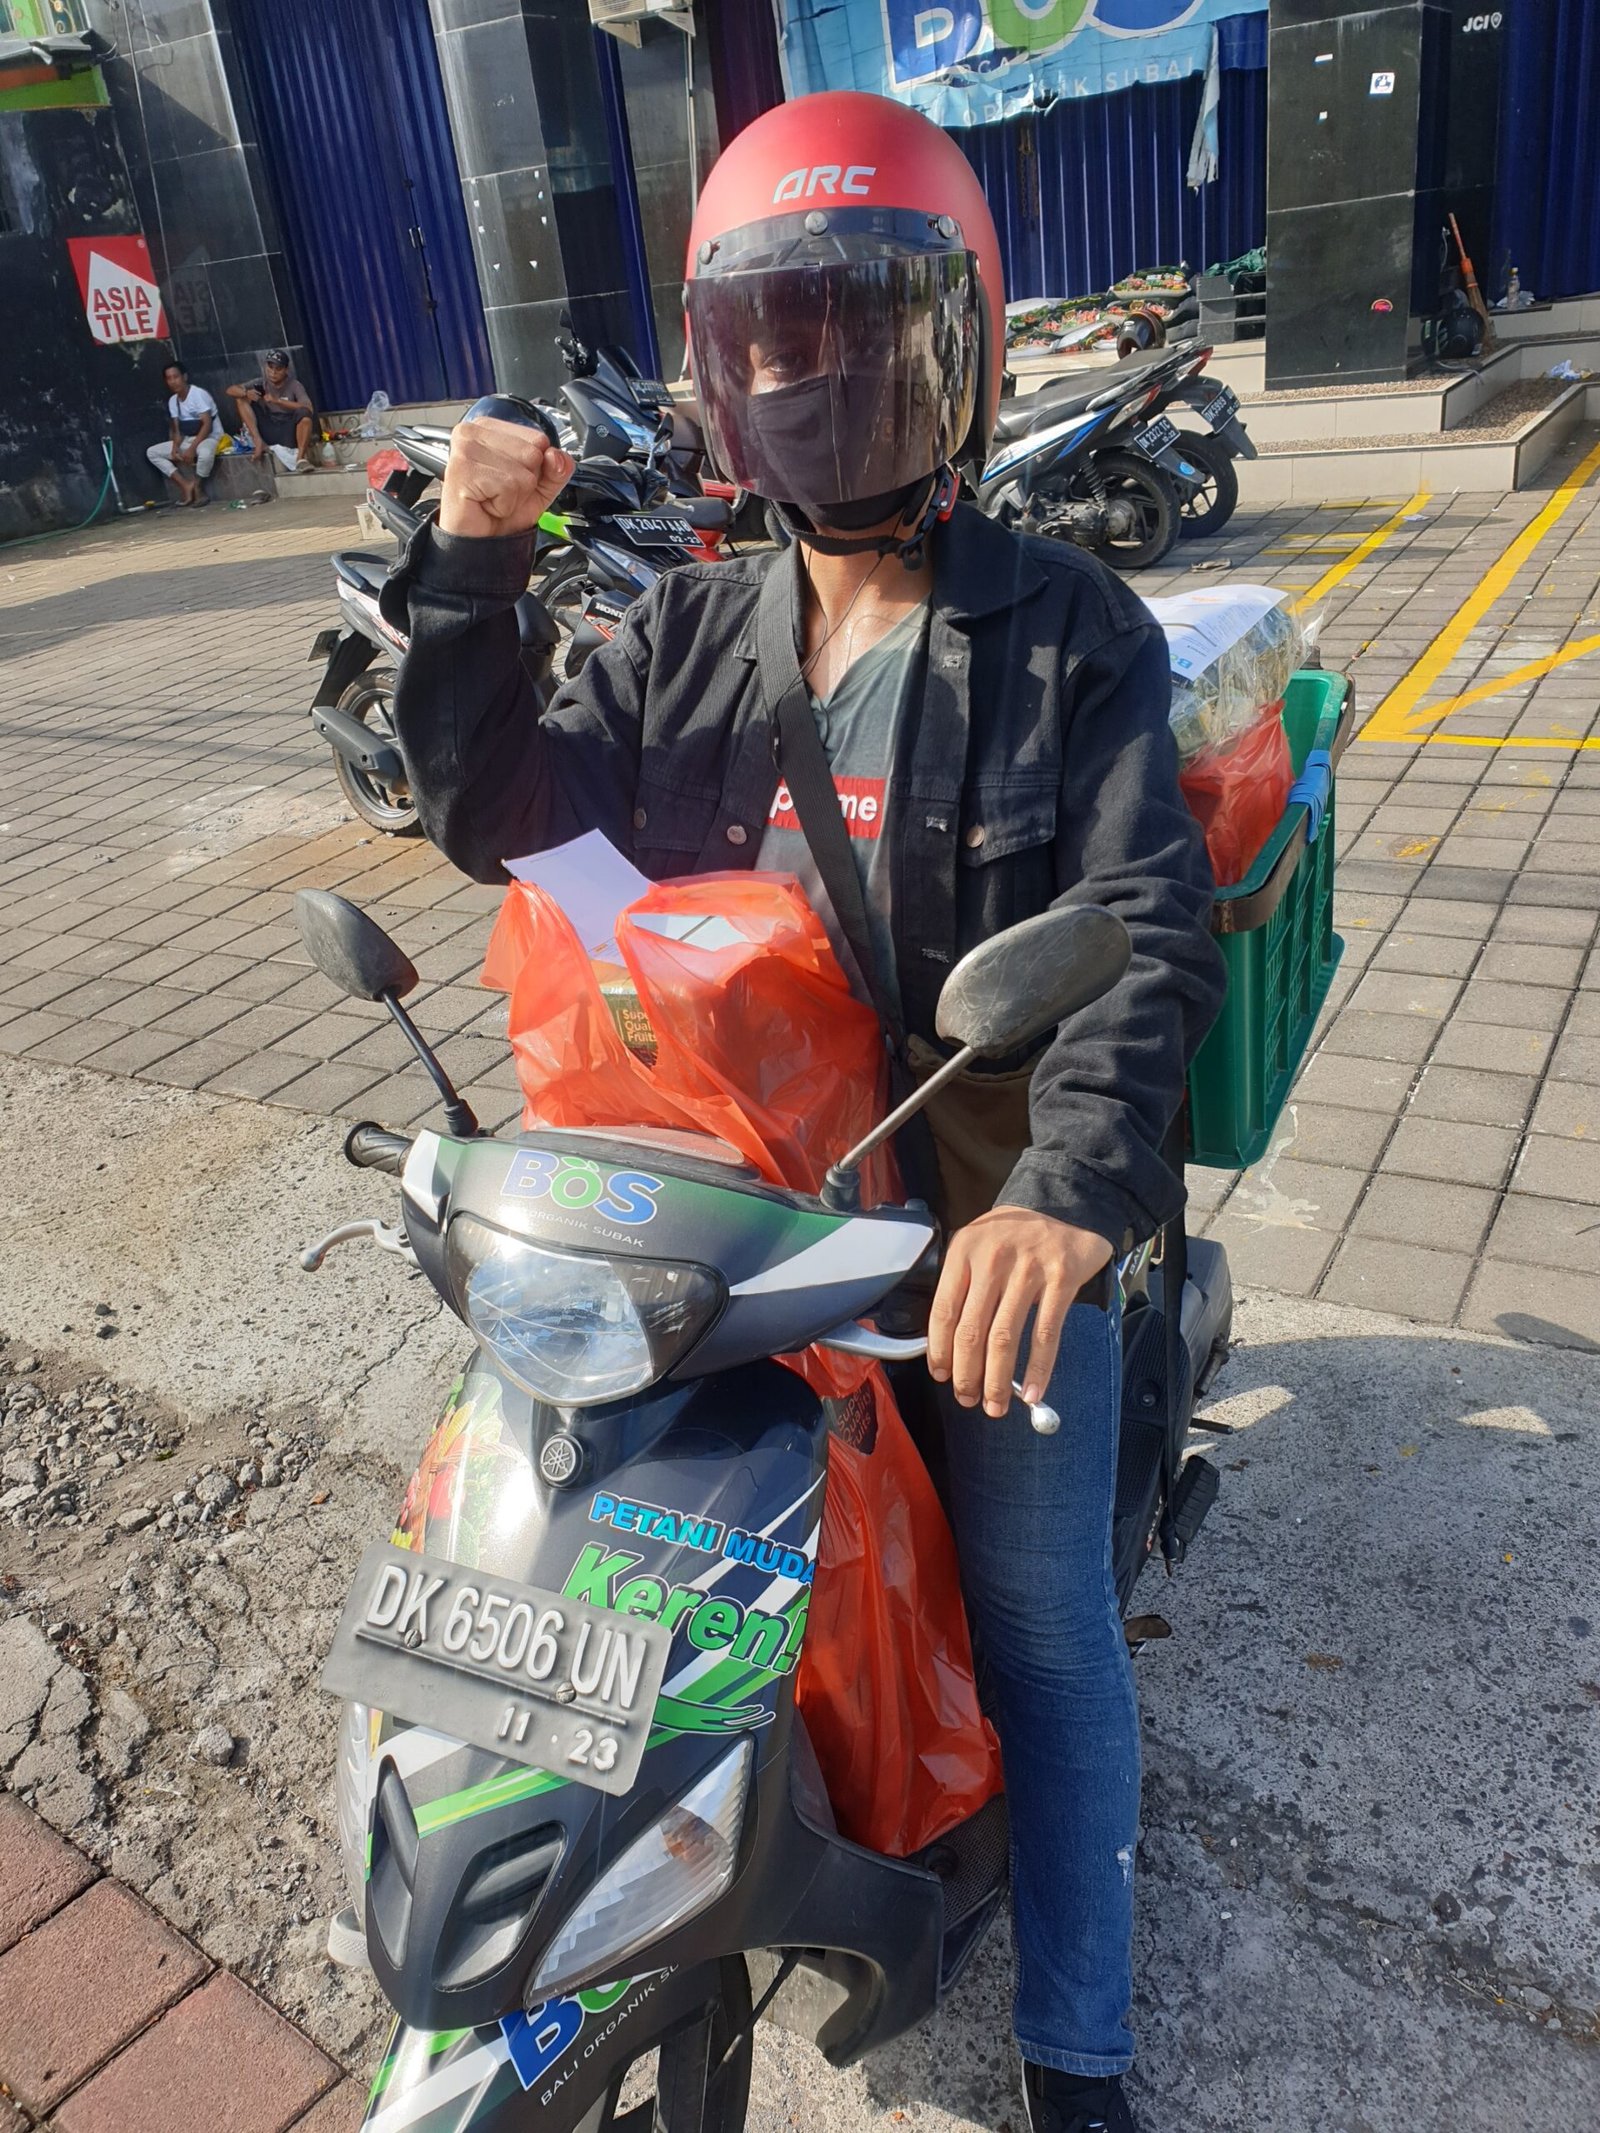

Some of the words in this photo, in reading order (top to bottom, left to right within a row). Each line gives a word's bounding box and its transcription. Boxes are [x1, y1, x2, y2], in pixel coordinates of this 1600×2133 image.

[772, 164, 877, 204] ARC
[93, 285, 153, 313] ASIA
[95, 310, 154, 338] TILE
[634, 518, 668, 531] 2047
[499, 1149, 665, 1225] BOS
[592, 1225, 646, 1248] SUBAK
[589, 1491, 725, 1552] PETANI
[560, 1542, 808, 1675] Keren!
[366, 1564, 447, 1641] DK
[443, 1586, 565, 1680] 6506
[570, 1621, 647, 1709] UN
[540, 2060, 580, 2107] BALI
[583, 1983, 657, 2060] ORGANIK
